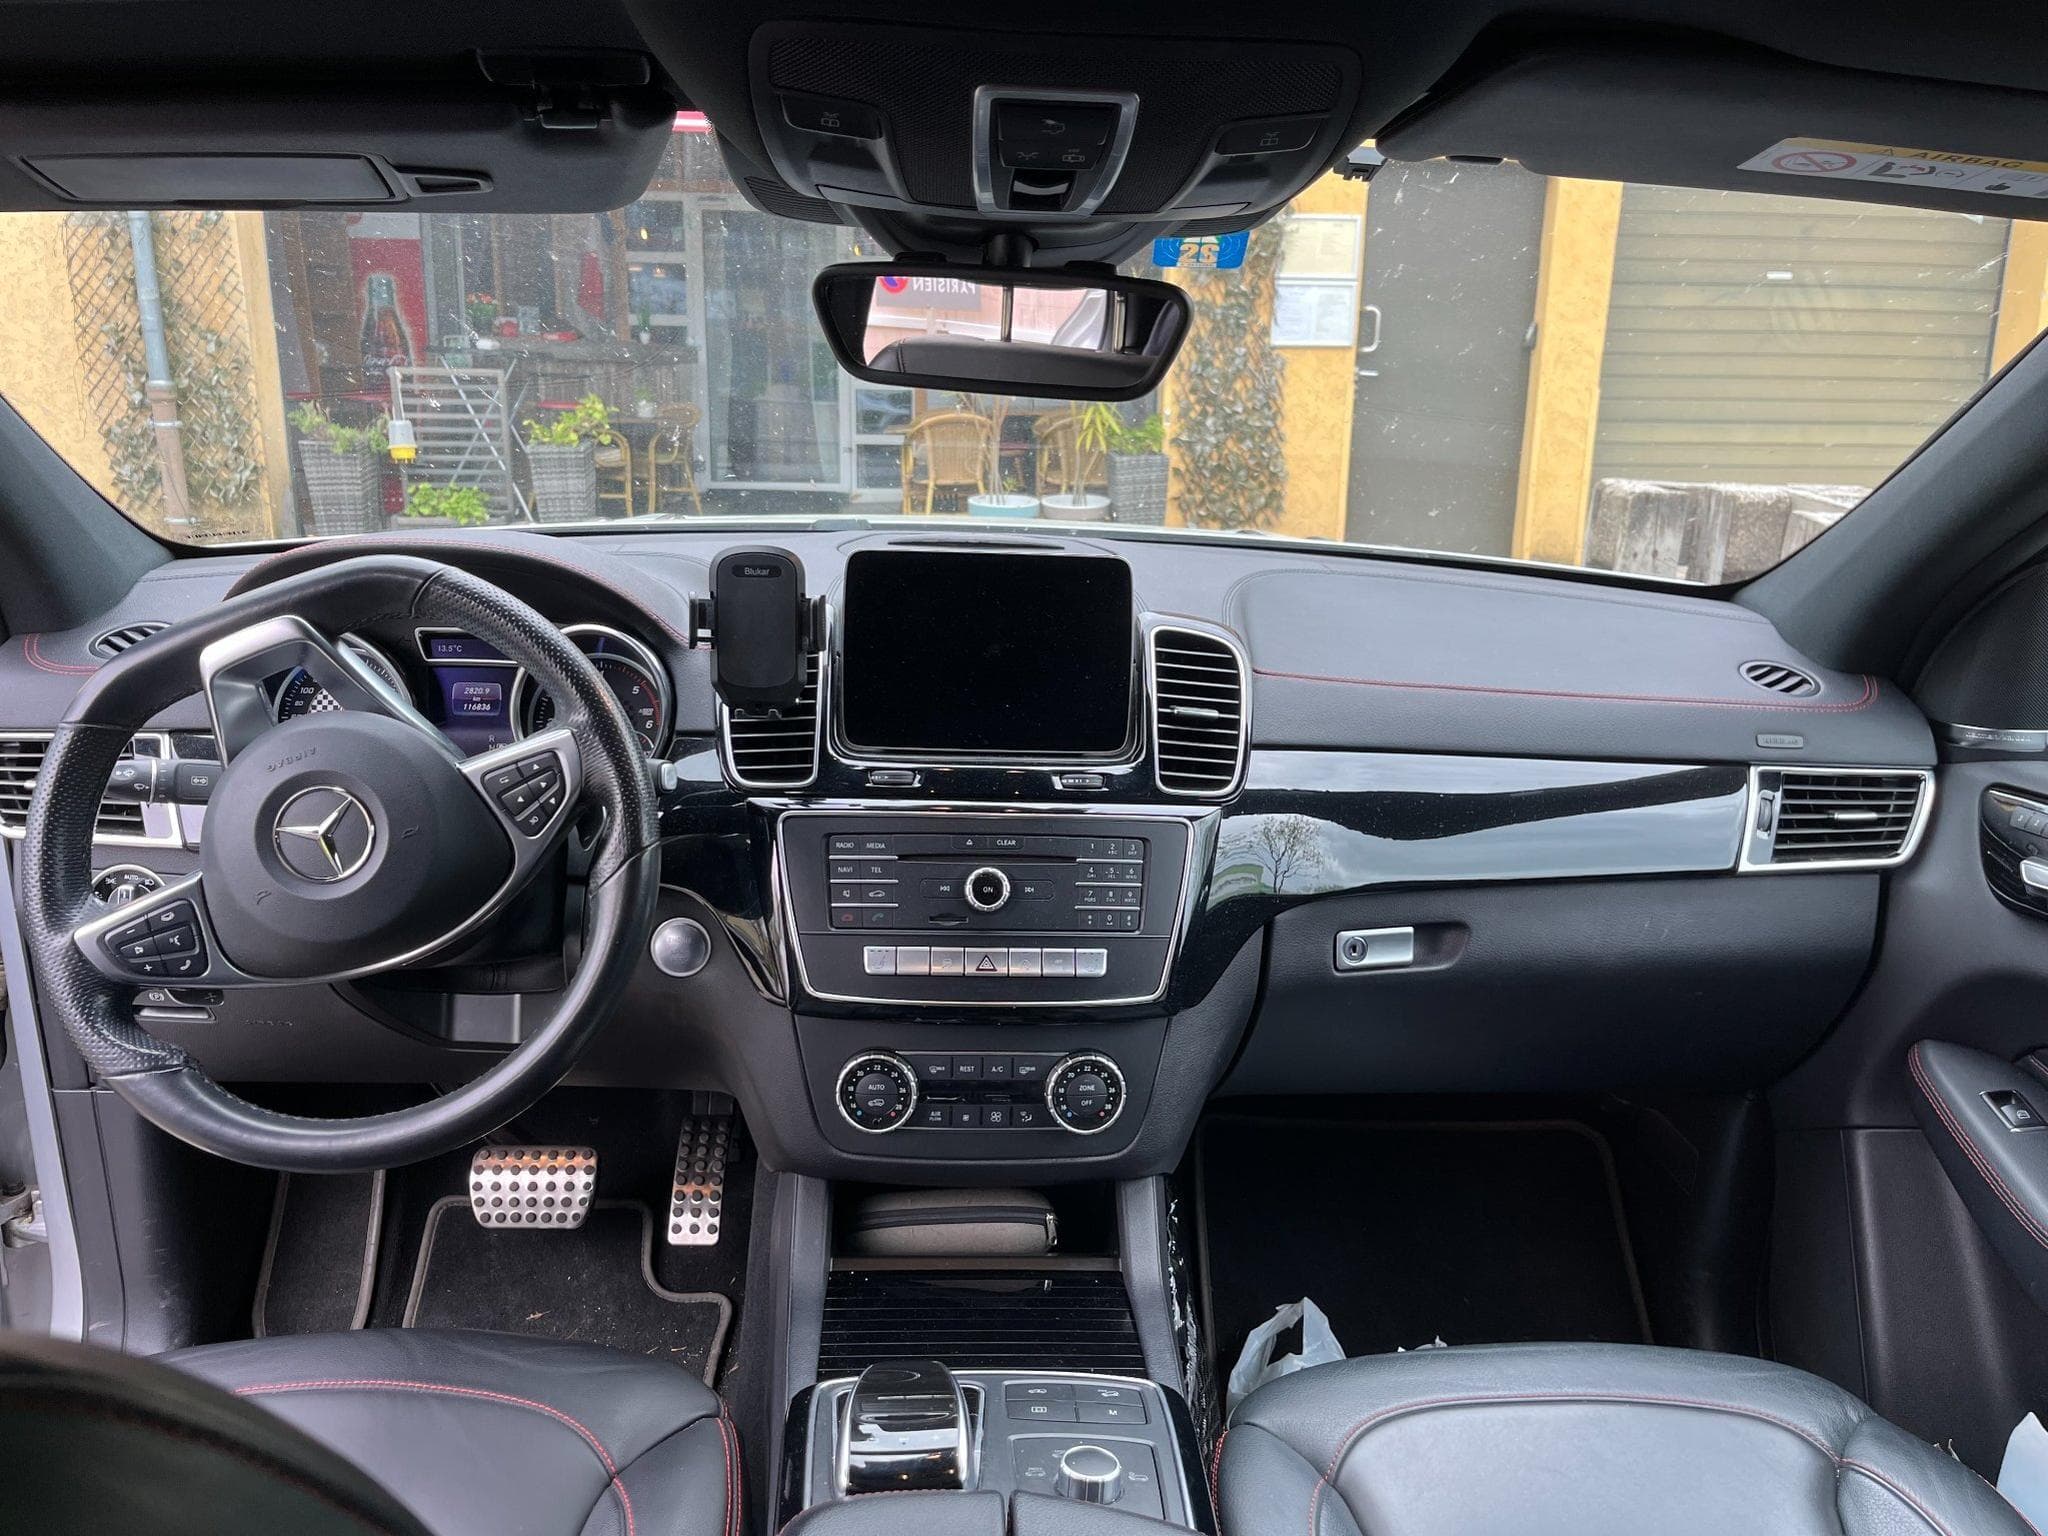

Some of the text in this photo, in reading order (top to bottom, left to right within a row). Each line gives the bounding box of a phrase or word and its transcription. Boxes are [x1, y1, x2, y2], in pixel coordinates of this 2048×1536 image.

[1913, 151, 2024, 168] AIRBAG
[463, 687, 490, 695] 2820.9
[632, 685, 640, 694] 5
[645, 721, 653, 729] 6
